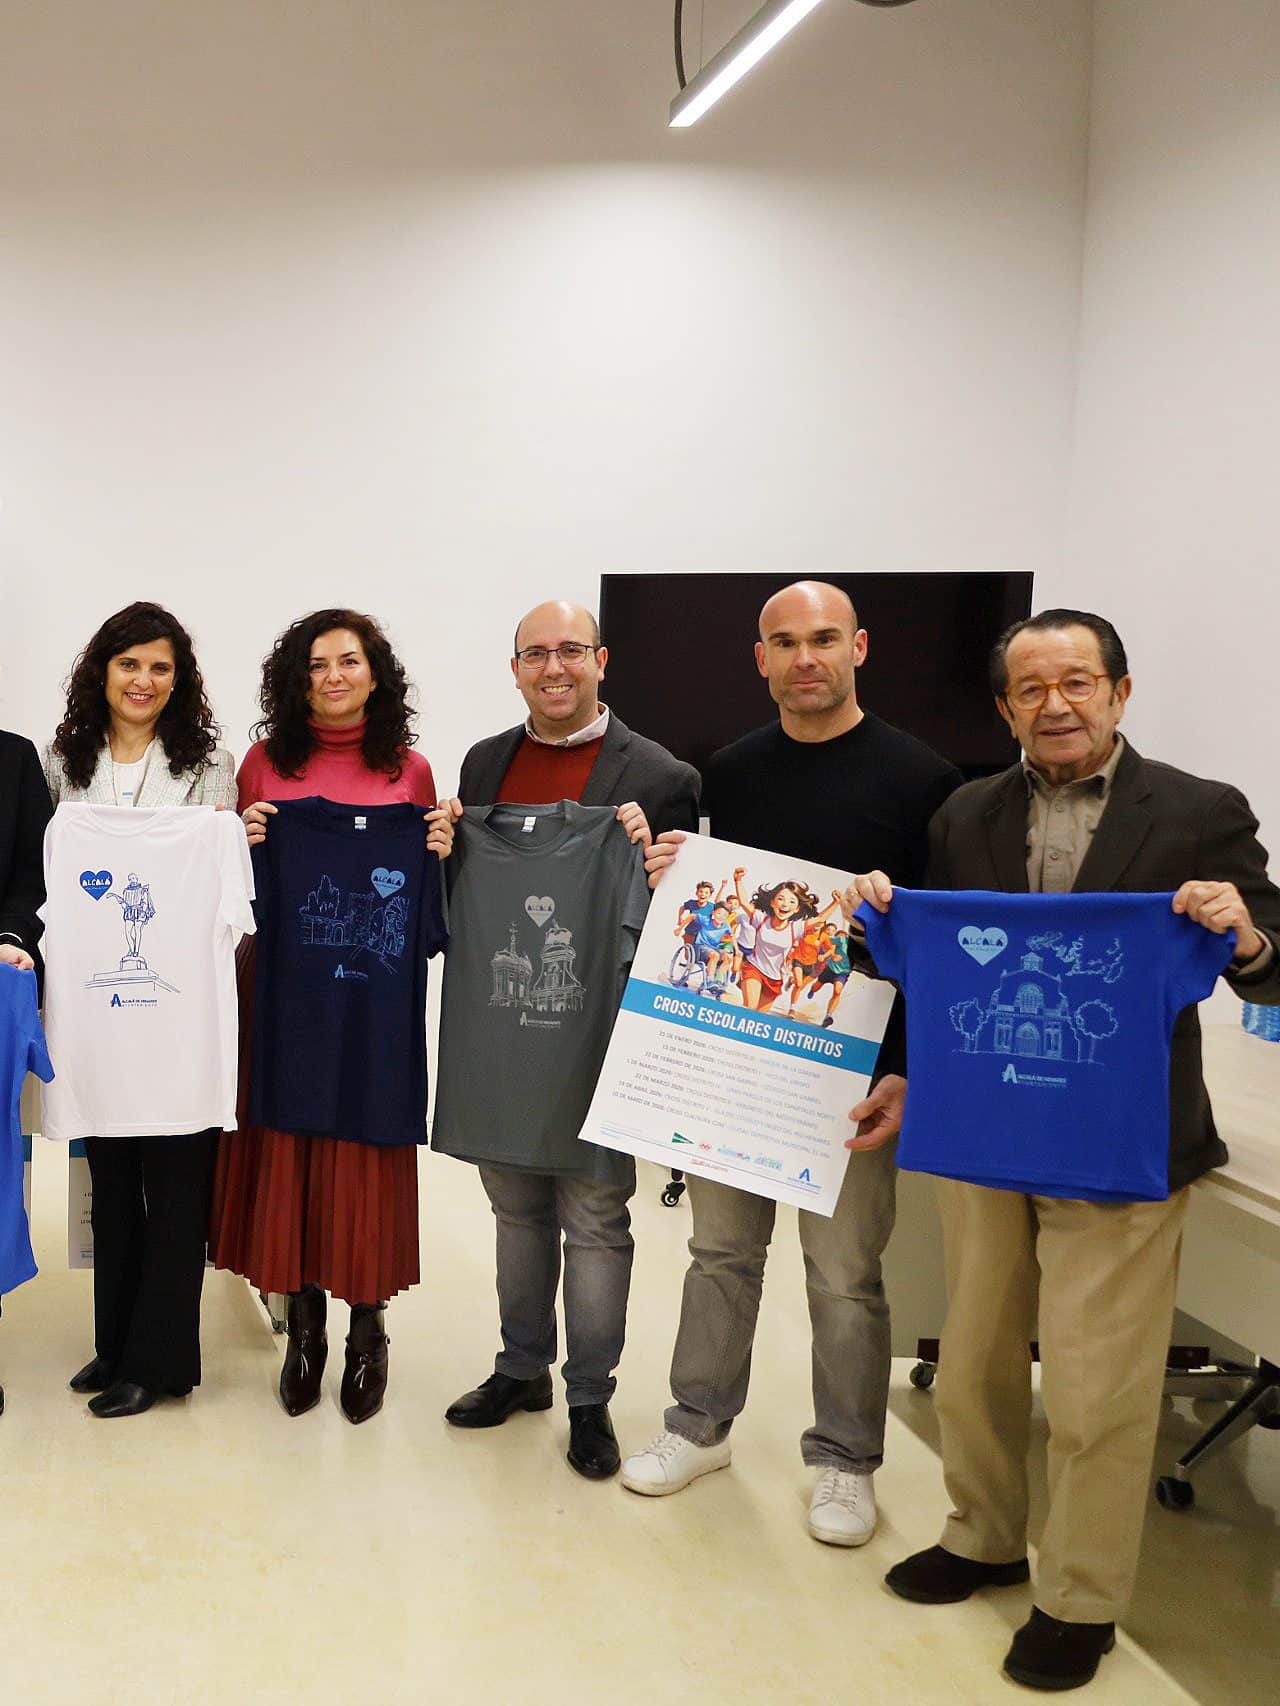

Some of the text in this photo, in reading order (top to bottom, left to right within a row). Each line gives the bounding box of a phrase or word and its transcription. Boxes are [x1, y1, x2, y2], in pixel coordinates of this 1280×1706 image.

[82, 876, 111, 887] ALCALÁ
[962, 936, 1004, 947] ALCALÁ
[653, 994, 844, 1059] CROSS ESCOLARES DISTRITOS
